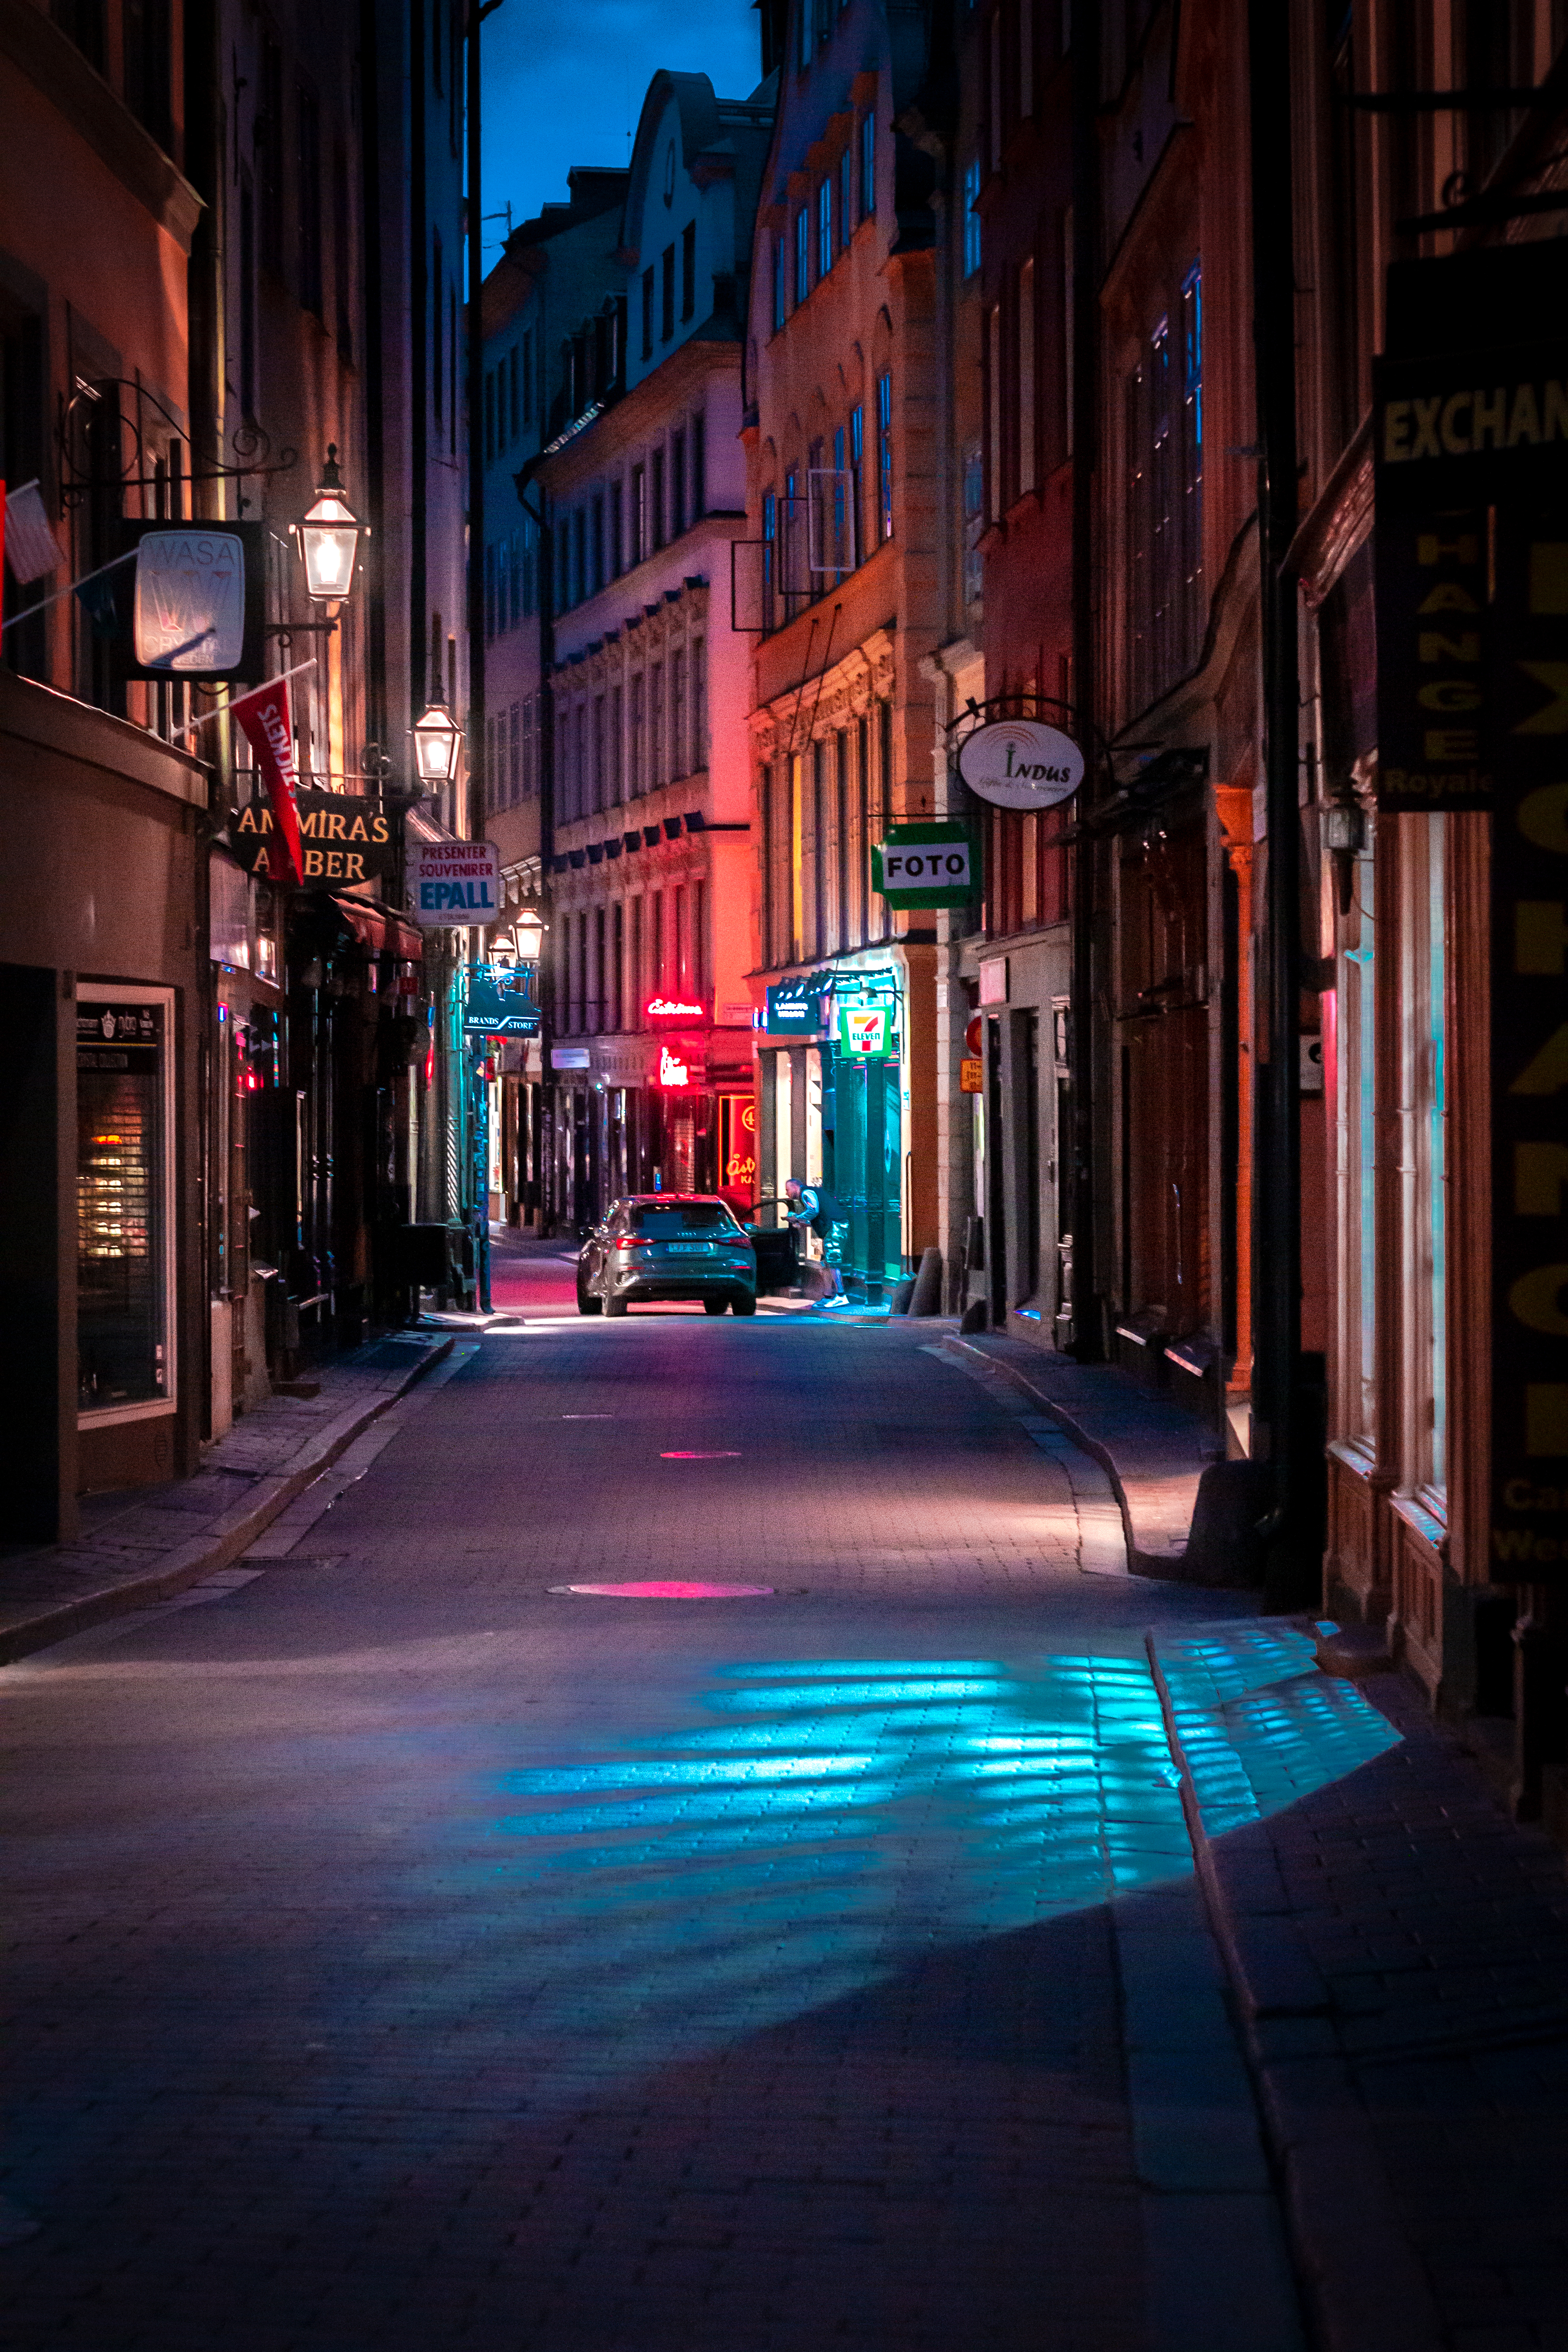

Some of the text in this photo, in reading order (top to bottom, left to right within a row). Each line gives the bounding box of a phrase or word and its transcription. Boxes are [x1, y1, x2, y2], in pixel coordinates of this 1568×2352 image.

[148, 540, 235, 565] WASA
[257, 703, 294, 788] TICKETS
[1005, 746, 1071, 783] INDUS
[252, 847, 366, 879] ABER
[422, 846, 486, 861] PRESENTER
[887, 853, 965, 877] FOTO
[419, 863, 493, 877] SOUVENIRER
[420, 882, 494, 910] EPALL
[469, 1016, 533, 1029] BRANDS STORE
[854, 1016, 878, 1032] 7
